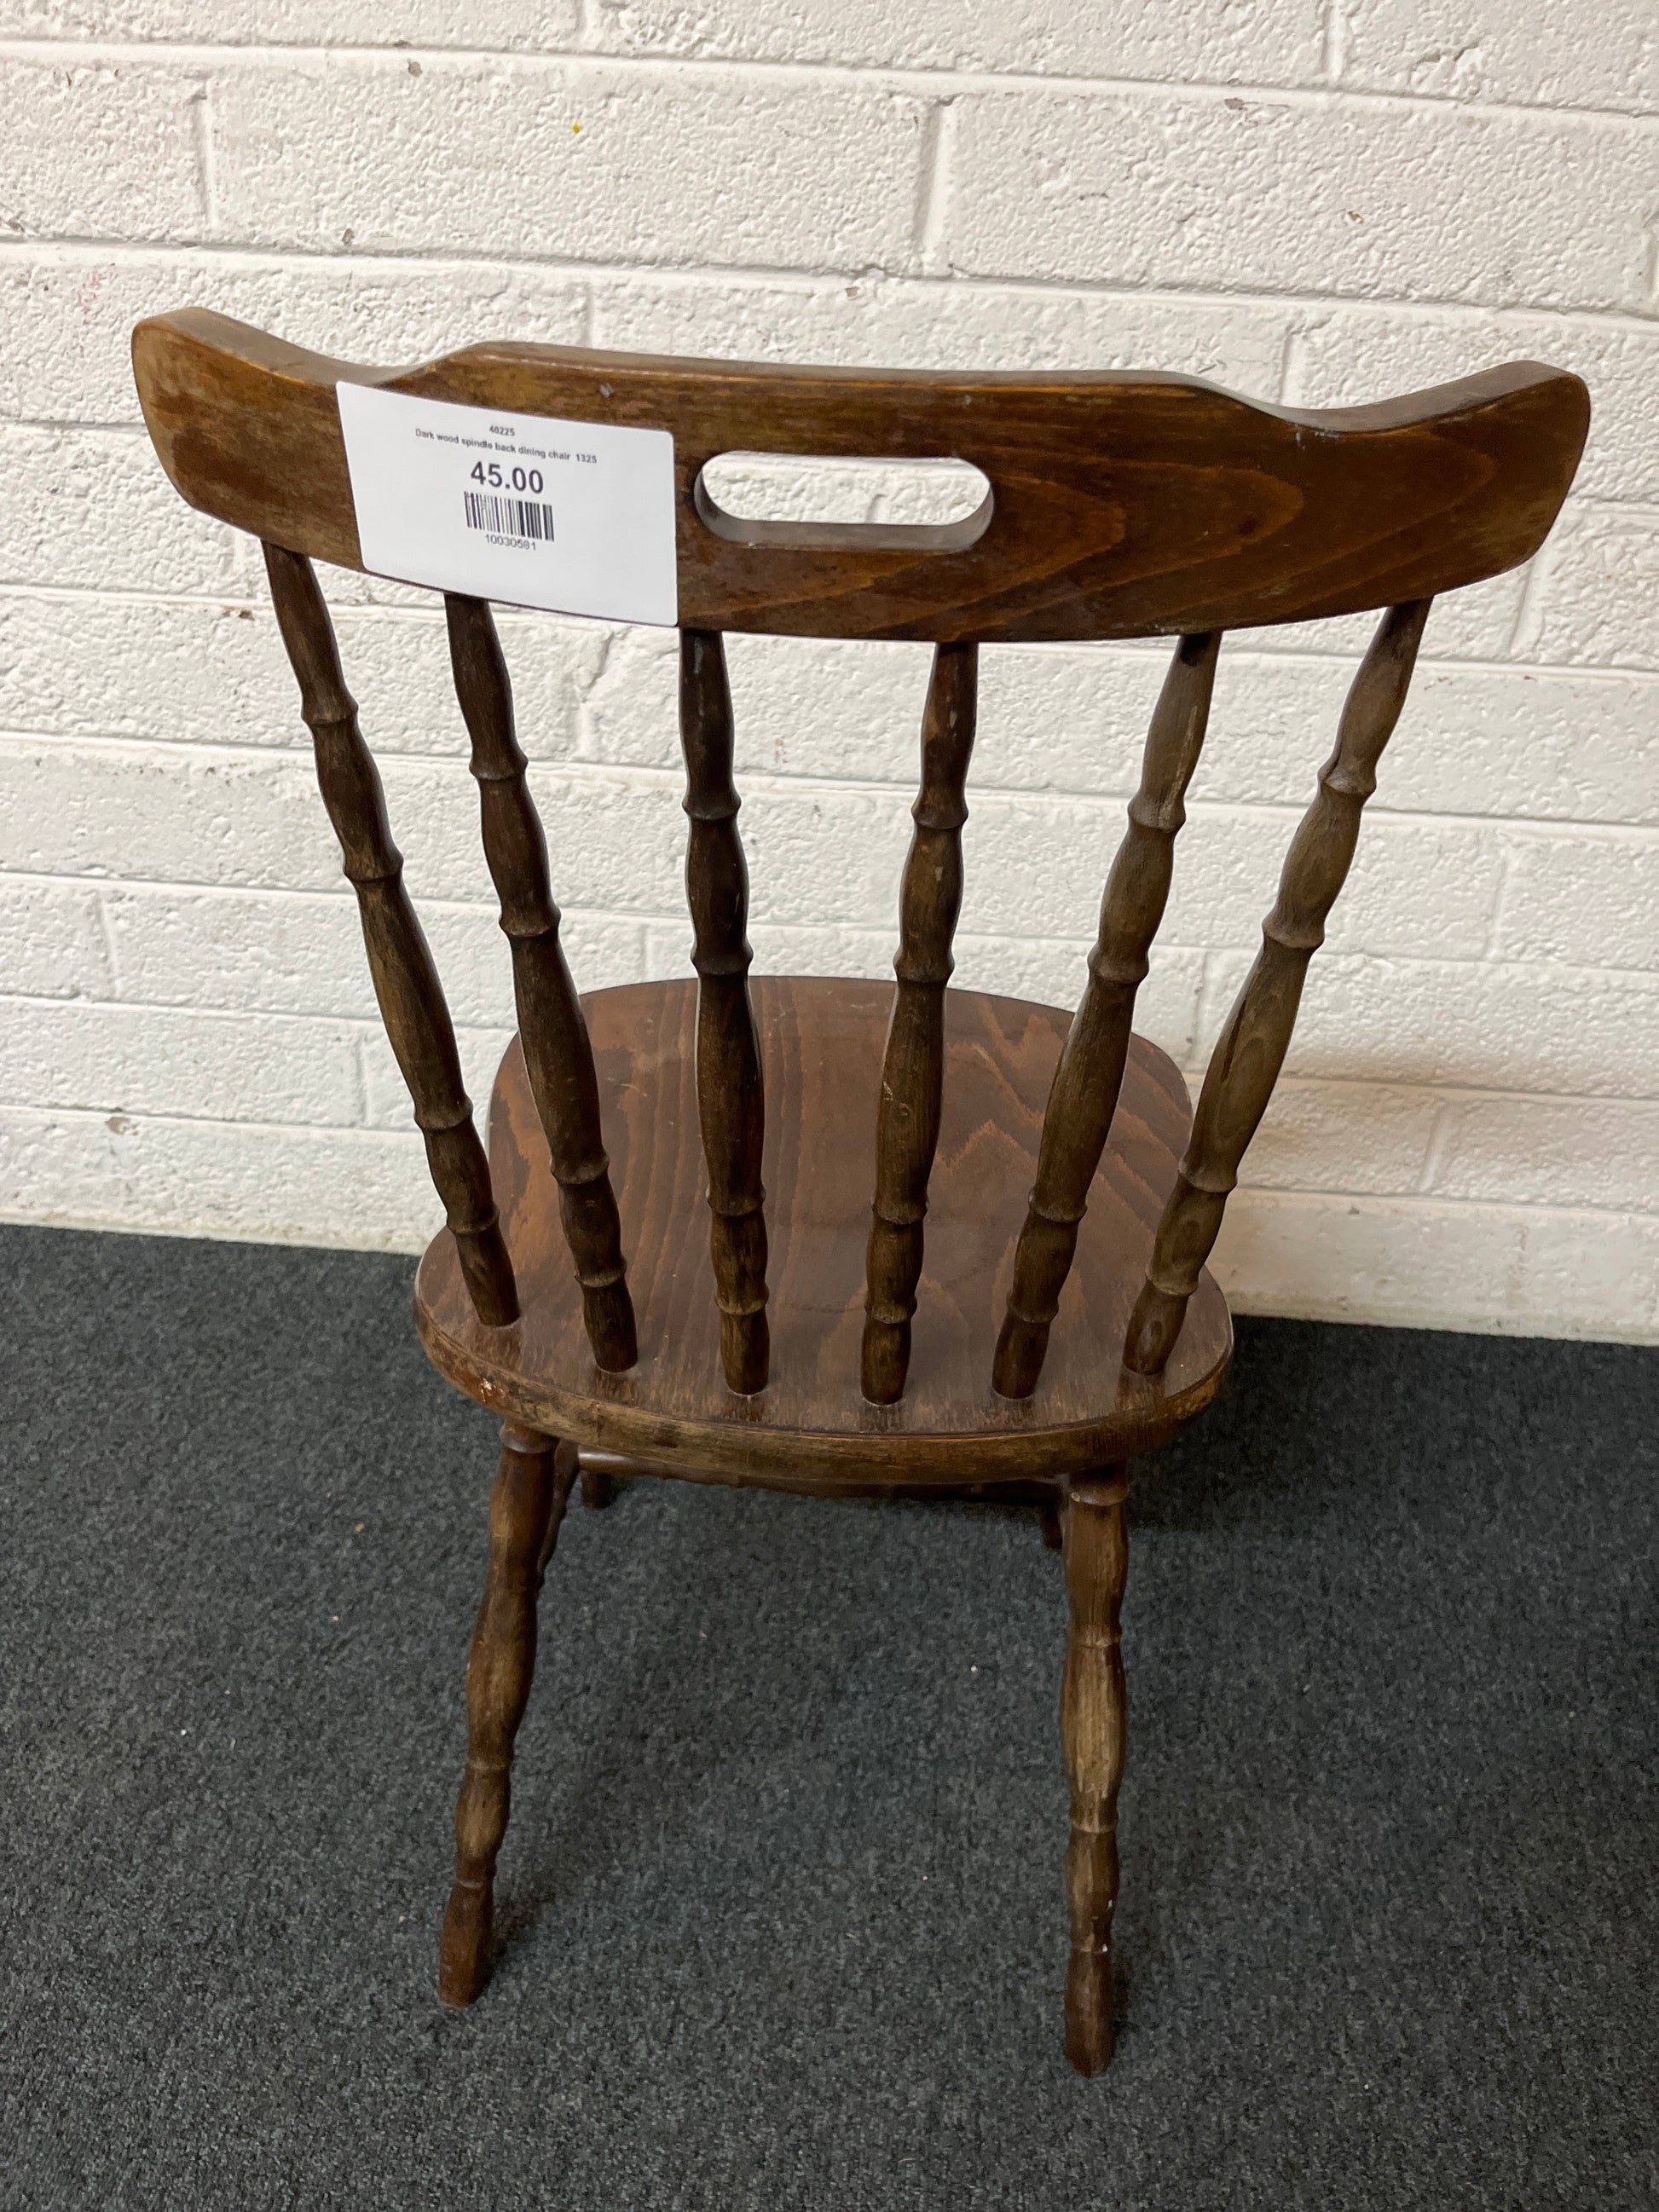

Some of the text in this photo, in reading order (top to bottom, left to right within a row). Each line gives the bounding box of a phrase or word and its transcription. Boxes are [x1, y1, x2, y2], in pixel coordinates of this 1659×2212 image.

[415, 428, 598, 464] Dark wood spindle back dining chair 1325
[471, 460, 544, 494] 45.00
